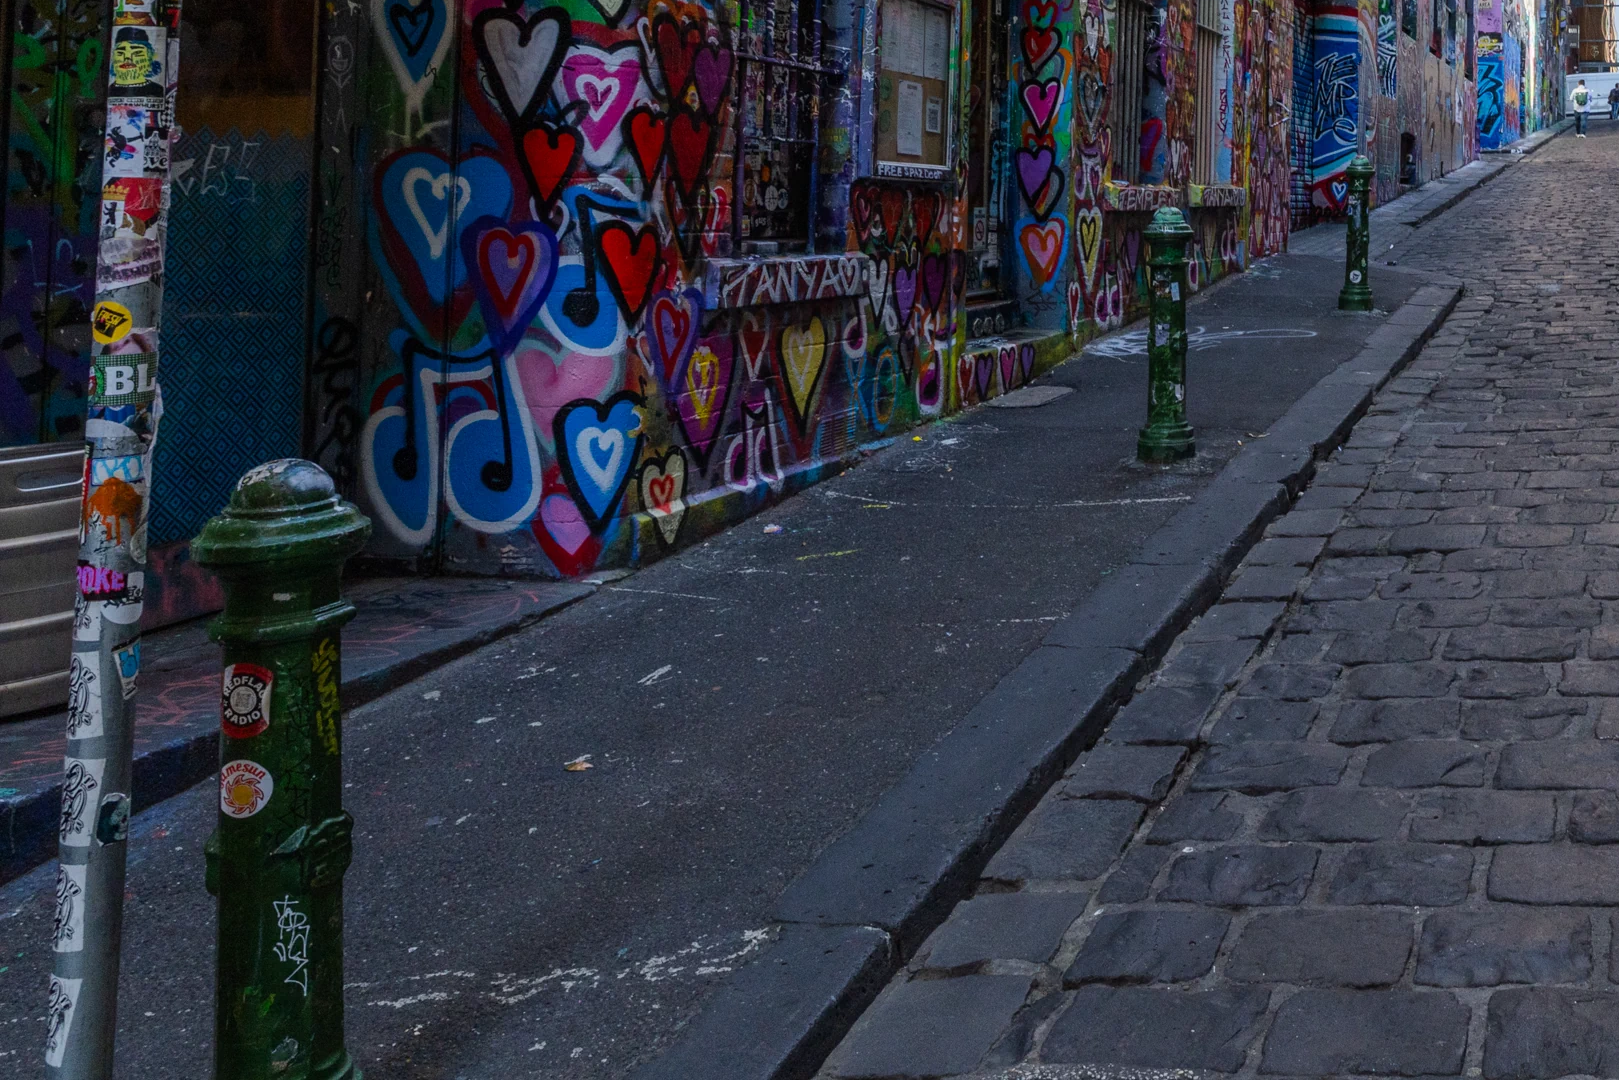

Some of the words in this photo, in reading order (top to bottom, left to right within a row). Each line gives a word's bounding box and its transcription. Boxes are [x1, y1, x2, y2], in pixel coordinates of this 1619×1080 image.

[878, 164, 903, 177] FREE
[722, 260, 843, 308] TANYA
[223, 708, 261, 726] RADIO
